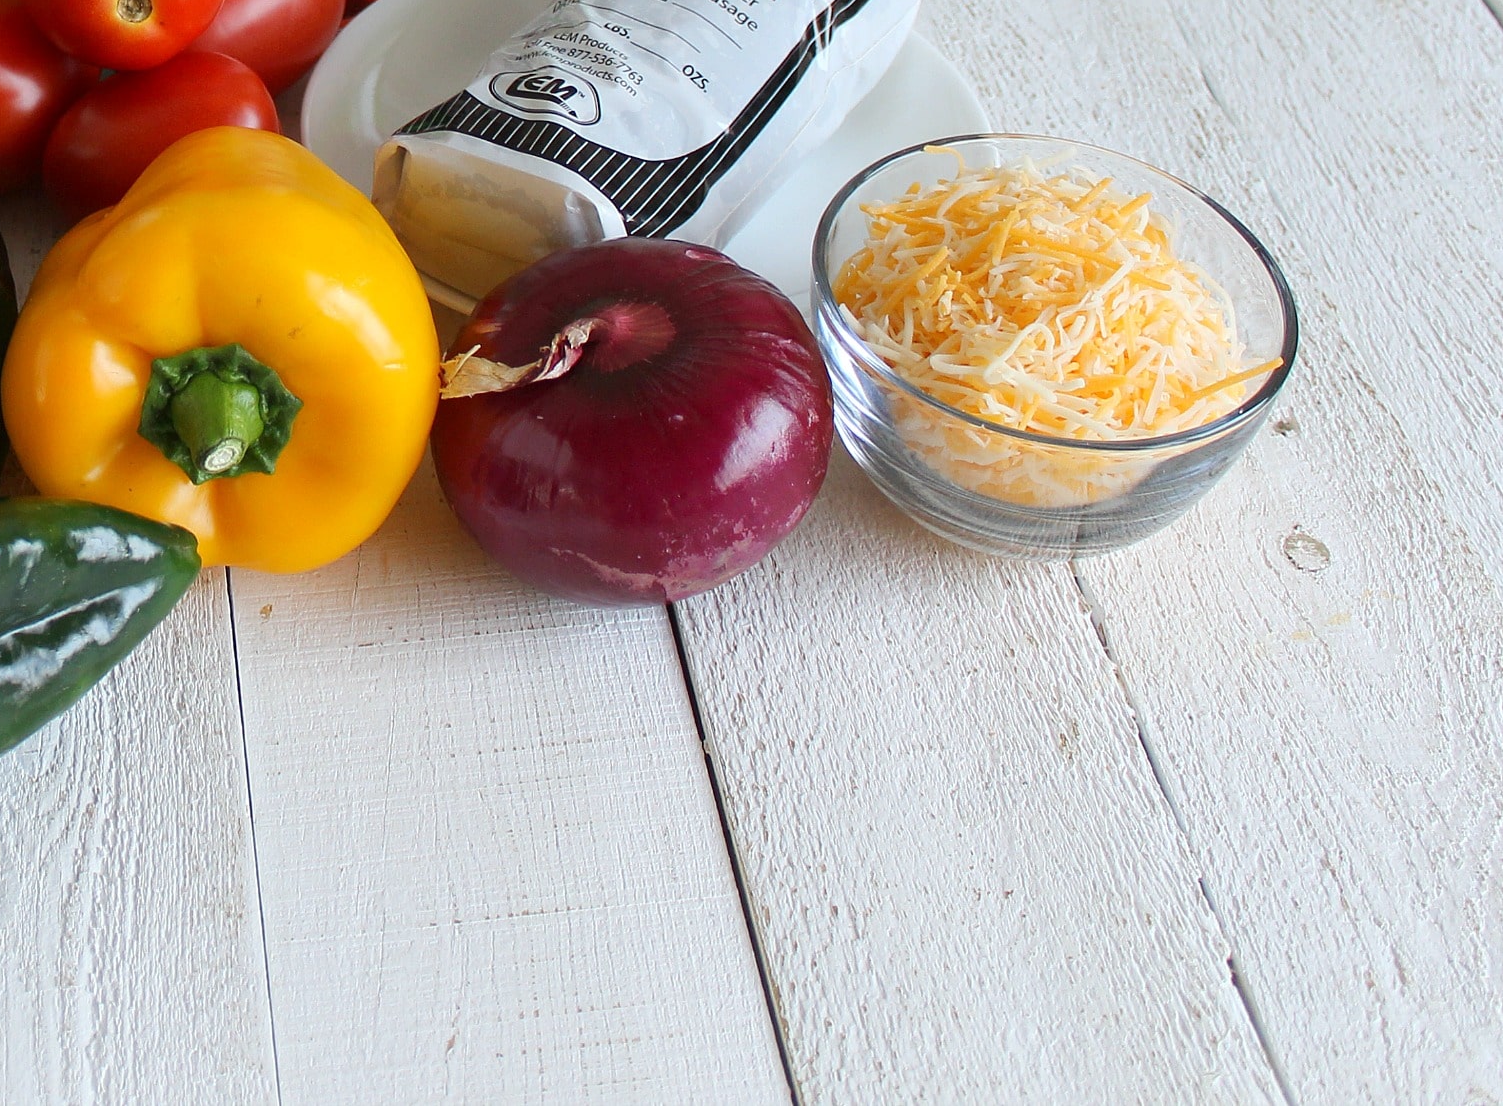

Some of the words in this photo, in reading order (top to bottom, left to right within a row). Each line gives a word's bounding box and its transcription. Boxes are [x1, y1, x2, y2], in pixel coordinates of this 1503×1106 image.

[579, 33, 628, 61] Products
[541, 41, 567, 55] Free
[567, 48, 644, 85] 877-536-7763
[506, 74, 578, 107] LEM
[681, 64, 708, 94] OZS.
